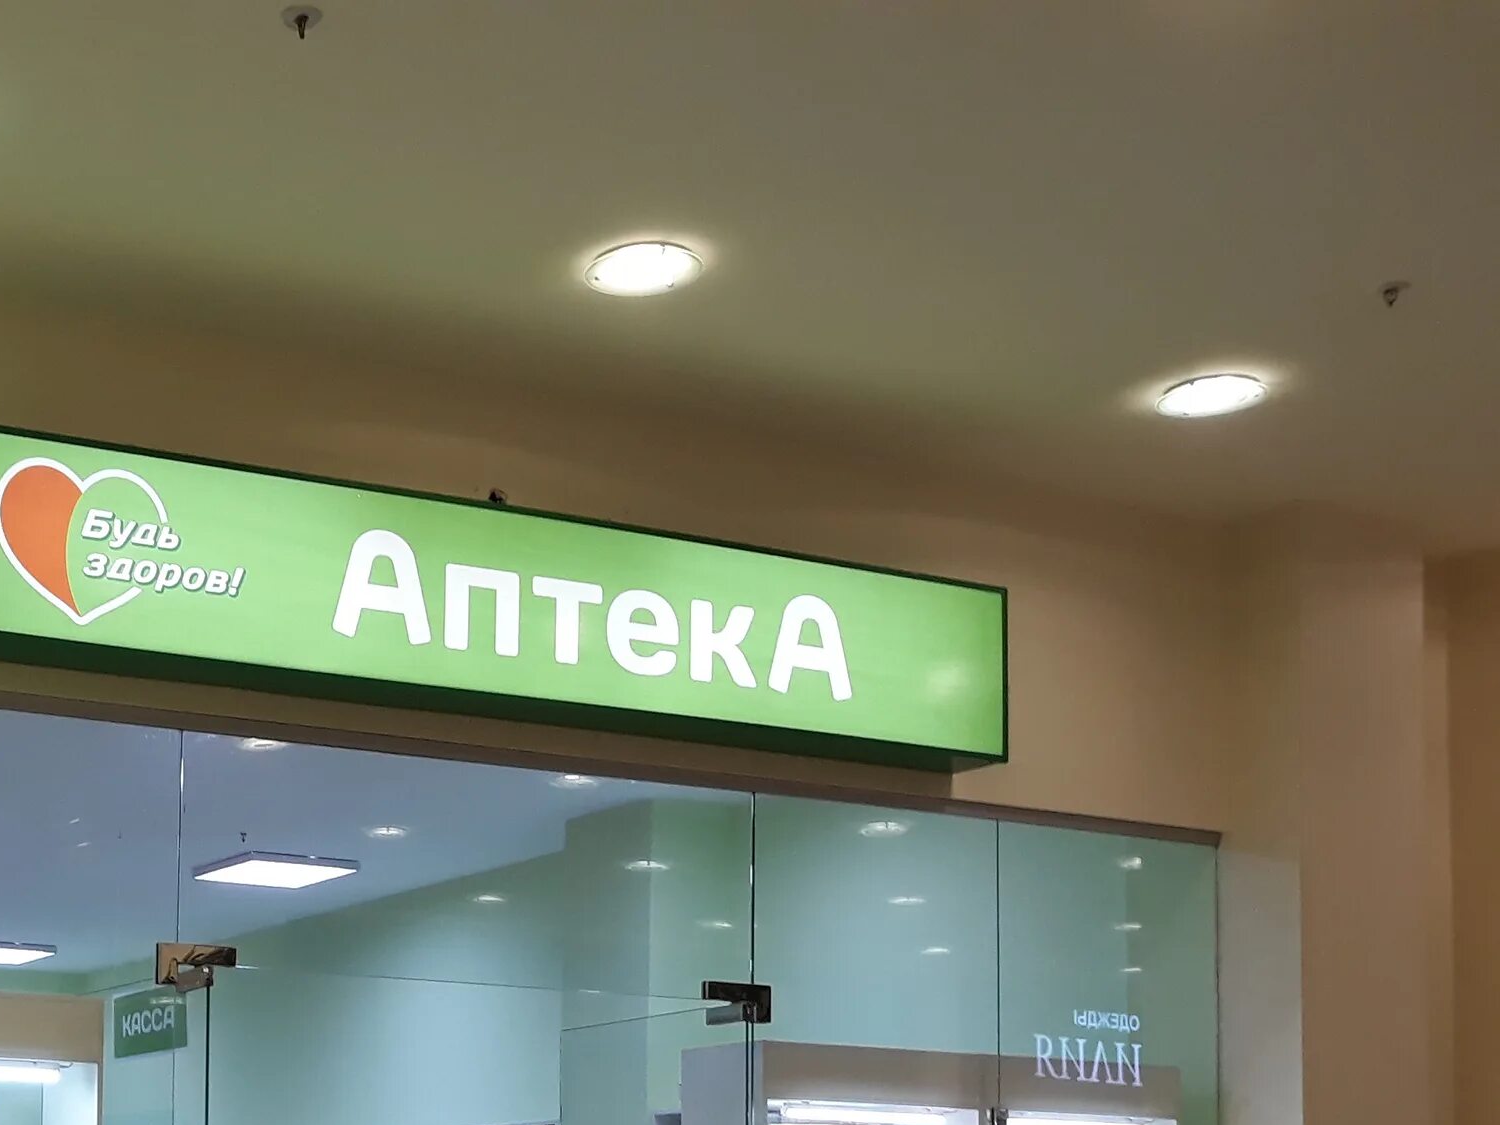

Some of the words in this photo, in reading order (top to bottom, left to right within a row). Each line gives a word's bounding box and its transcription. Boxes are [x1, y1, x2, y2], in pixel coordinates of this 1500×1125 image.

[81, 508, 181, 550] Будь
[83, 552, 246, 597] здоров!
[122, 1005, 174, 1038] КАССА
